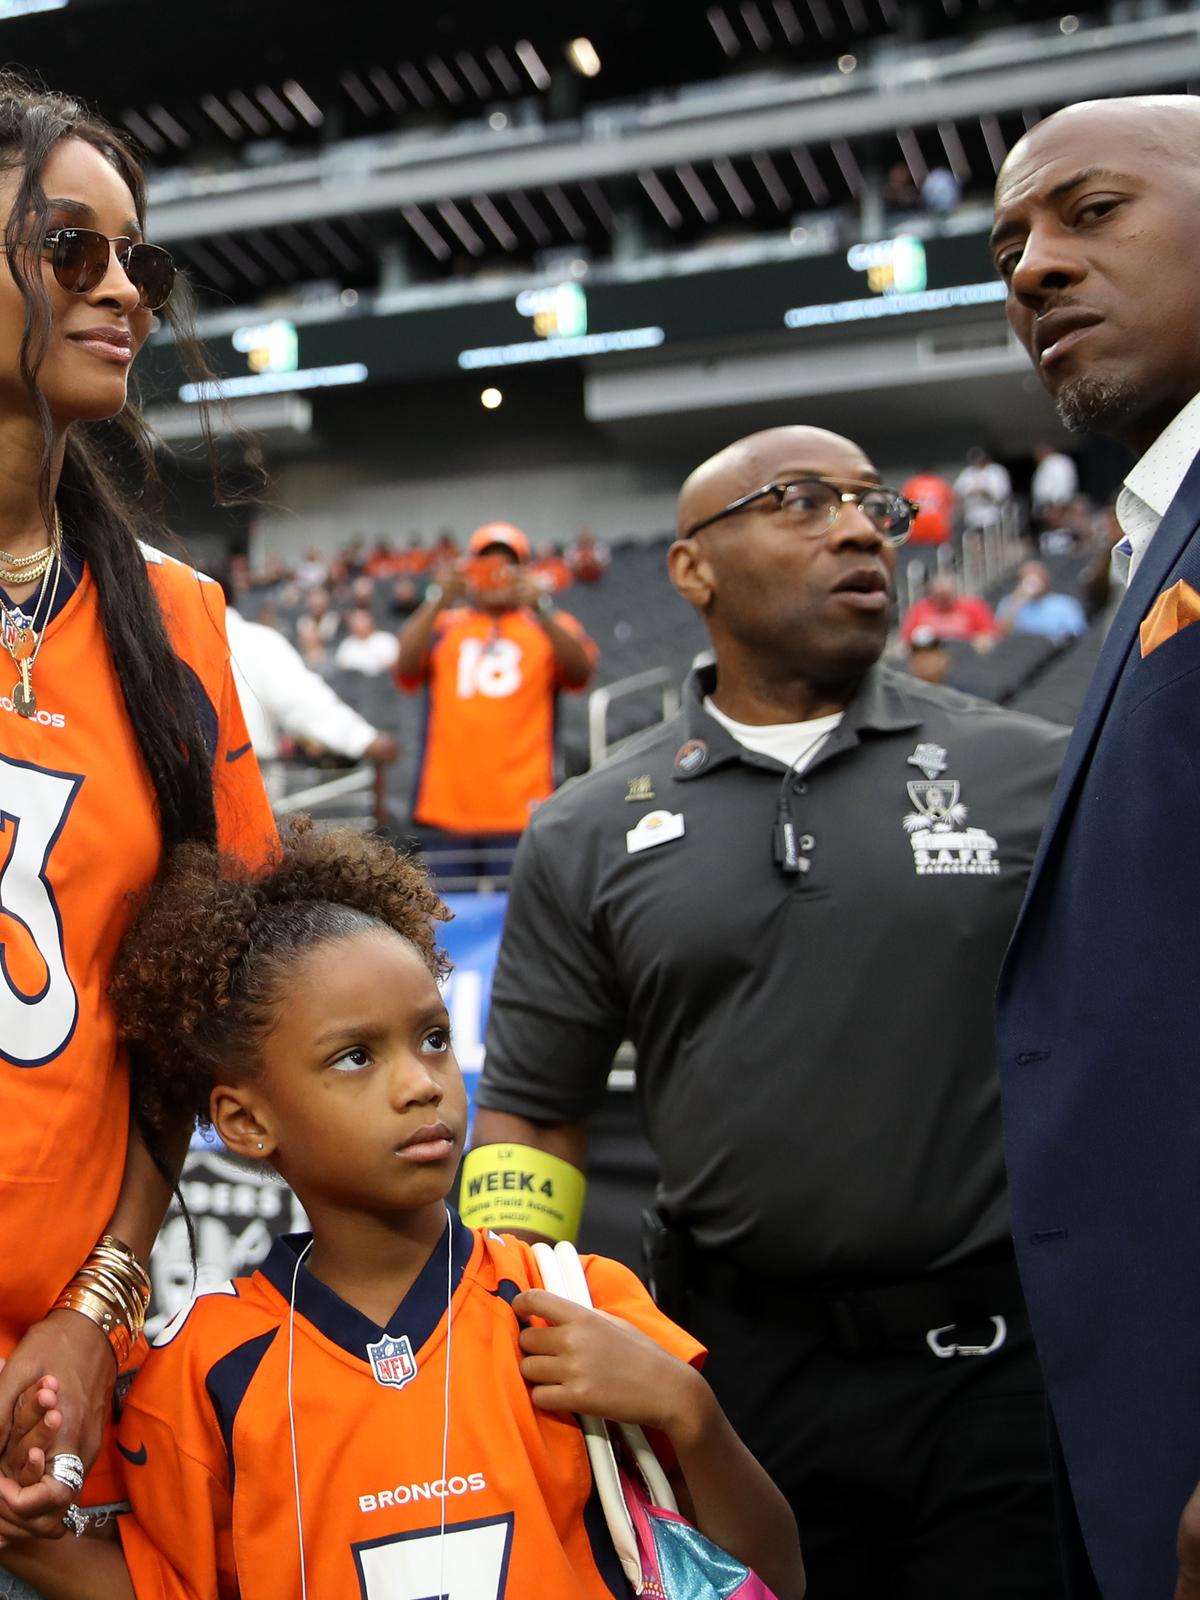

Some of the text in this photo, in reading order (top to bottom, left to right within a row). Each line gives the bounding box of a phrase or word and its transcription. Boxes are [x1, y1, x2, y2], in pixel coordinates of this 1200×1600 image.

[469, 1171, 553, 1198] WEEK 4
[377, 1355, 412, 1381] NFL
[358, 1472, 487, 1513] BRONCOS
